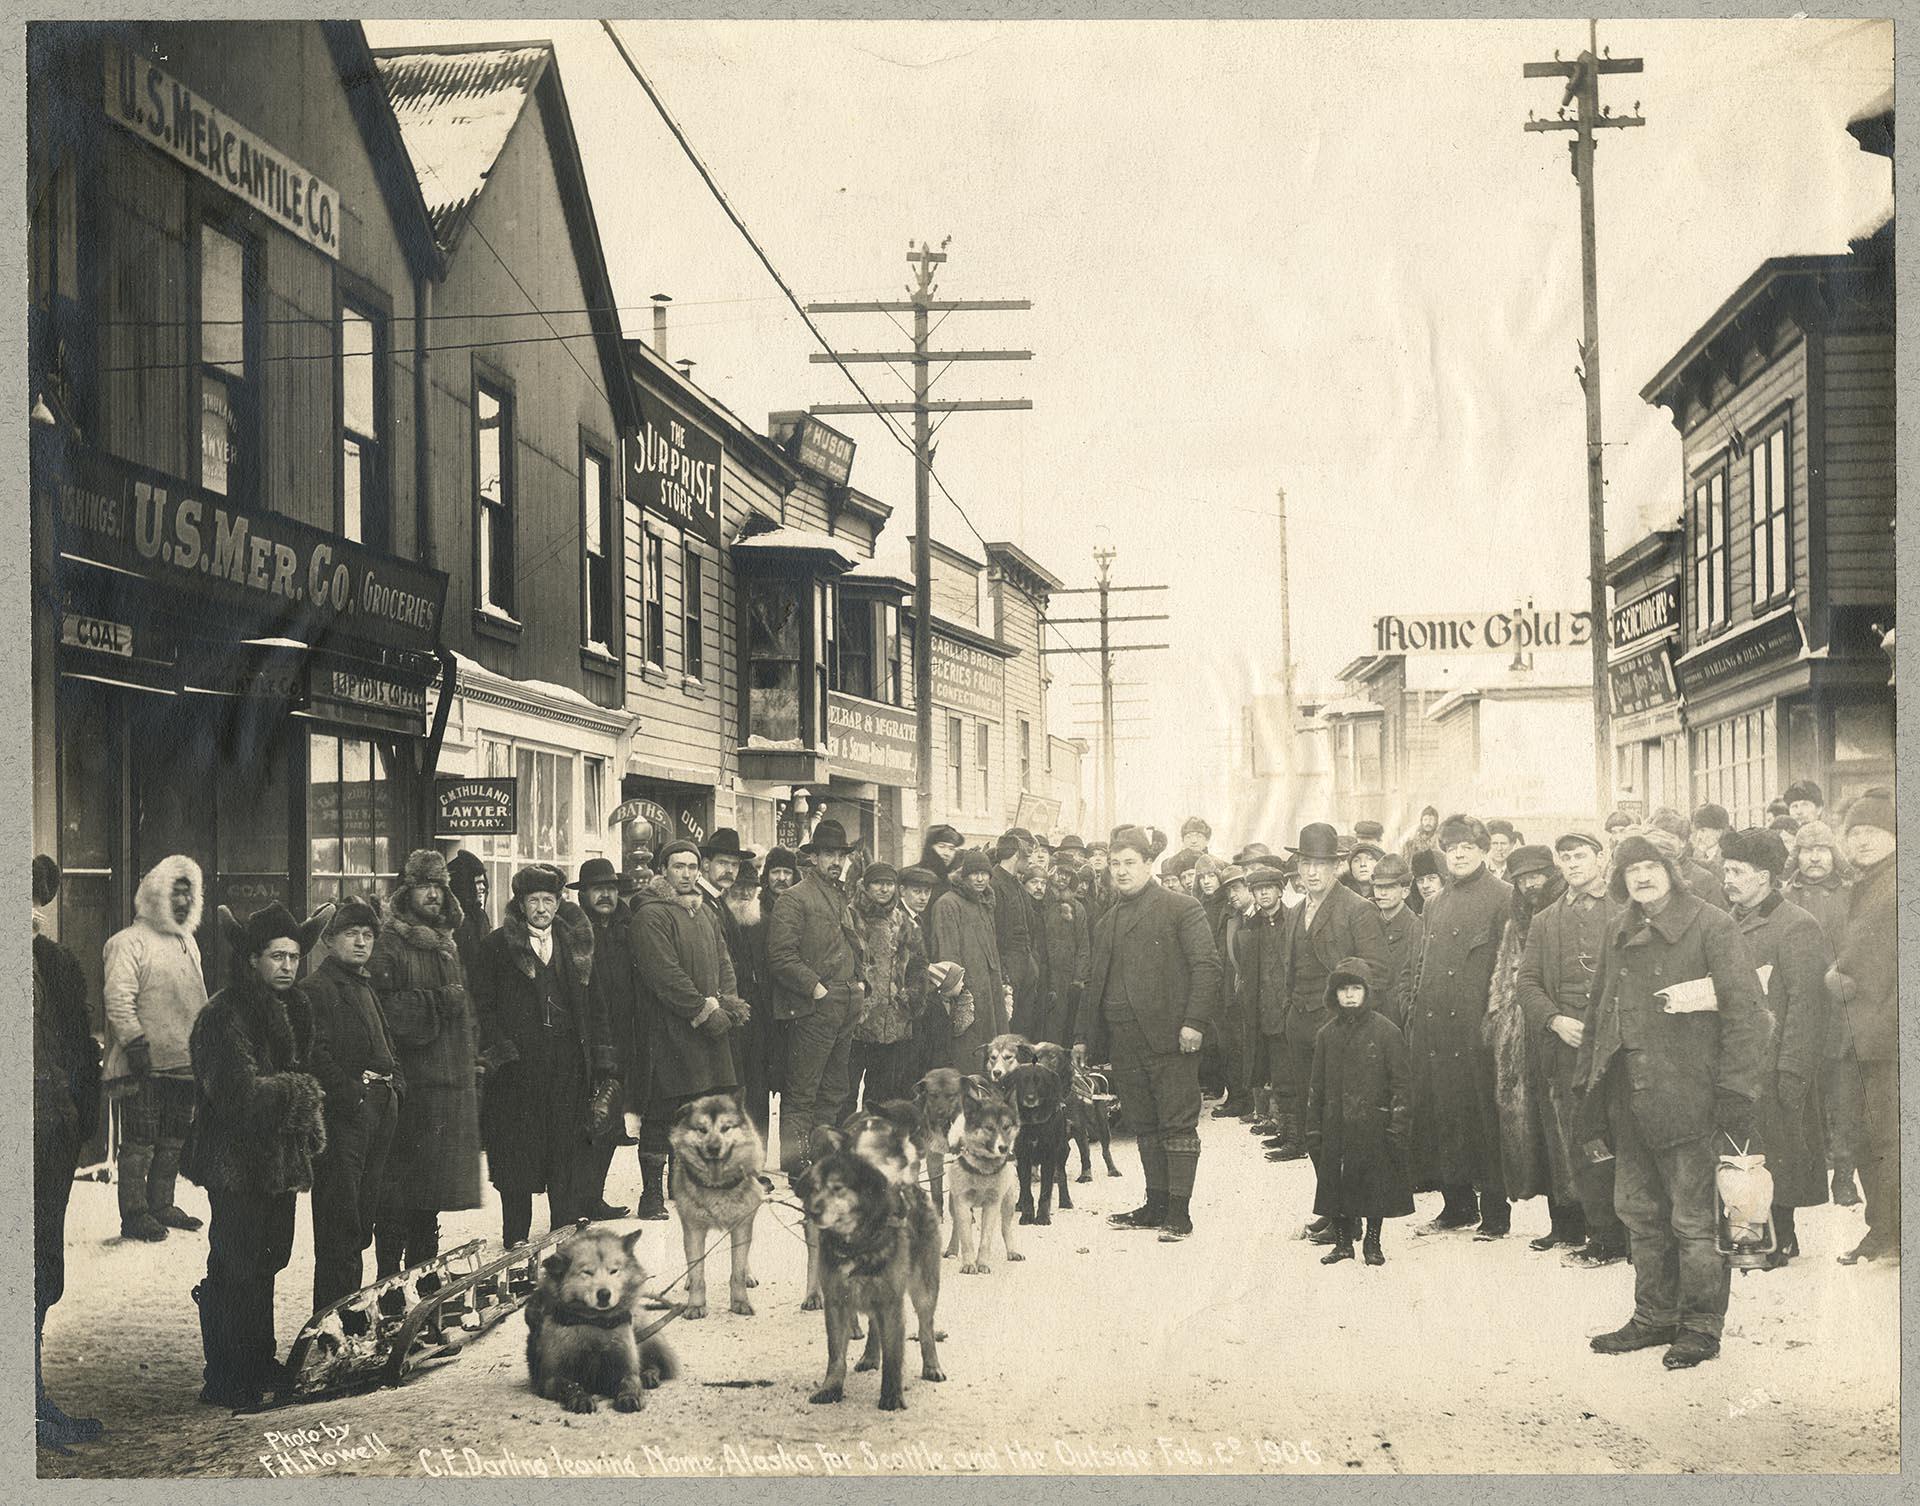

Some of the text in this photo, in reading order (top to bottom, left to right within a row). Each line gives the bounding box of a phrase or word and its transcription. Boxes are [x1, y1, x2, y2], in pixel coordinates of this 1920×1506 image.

[669, 420, 686, 450] THE
[633, 421, 716, 520] SURPRISE
[660, 477, 693, 521] STORE
[363, 569, 436, 632] GROCERIES
[77, 618, 123, 652] COAL
[930, 656, 972, 687] OCERIES
